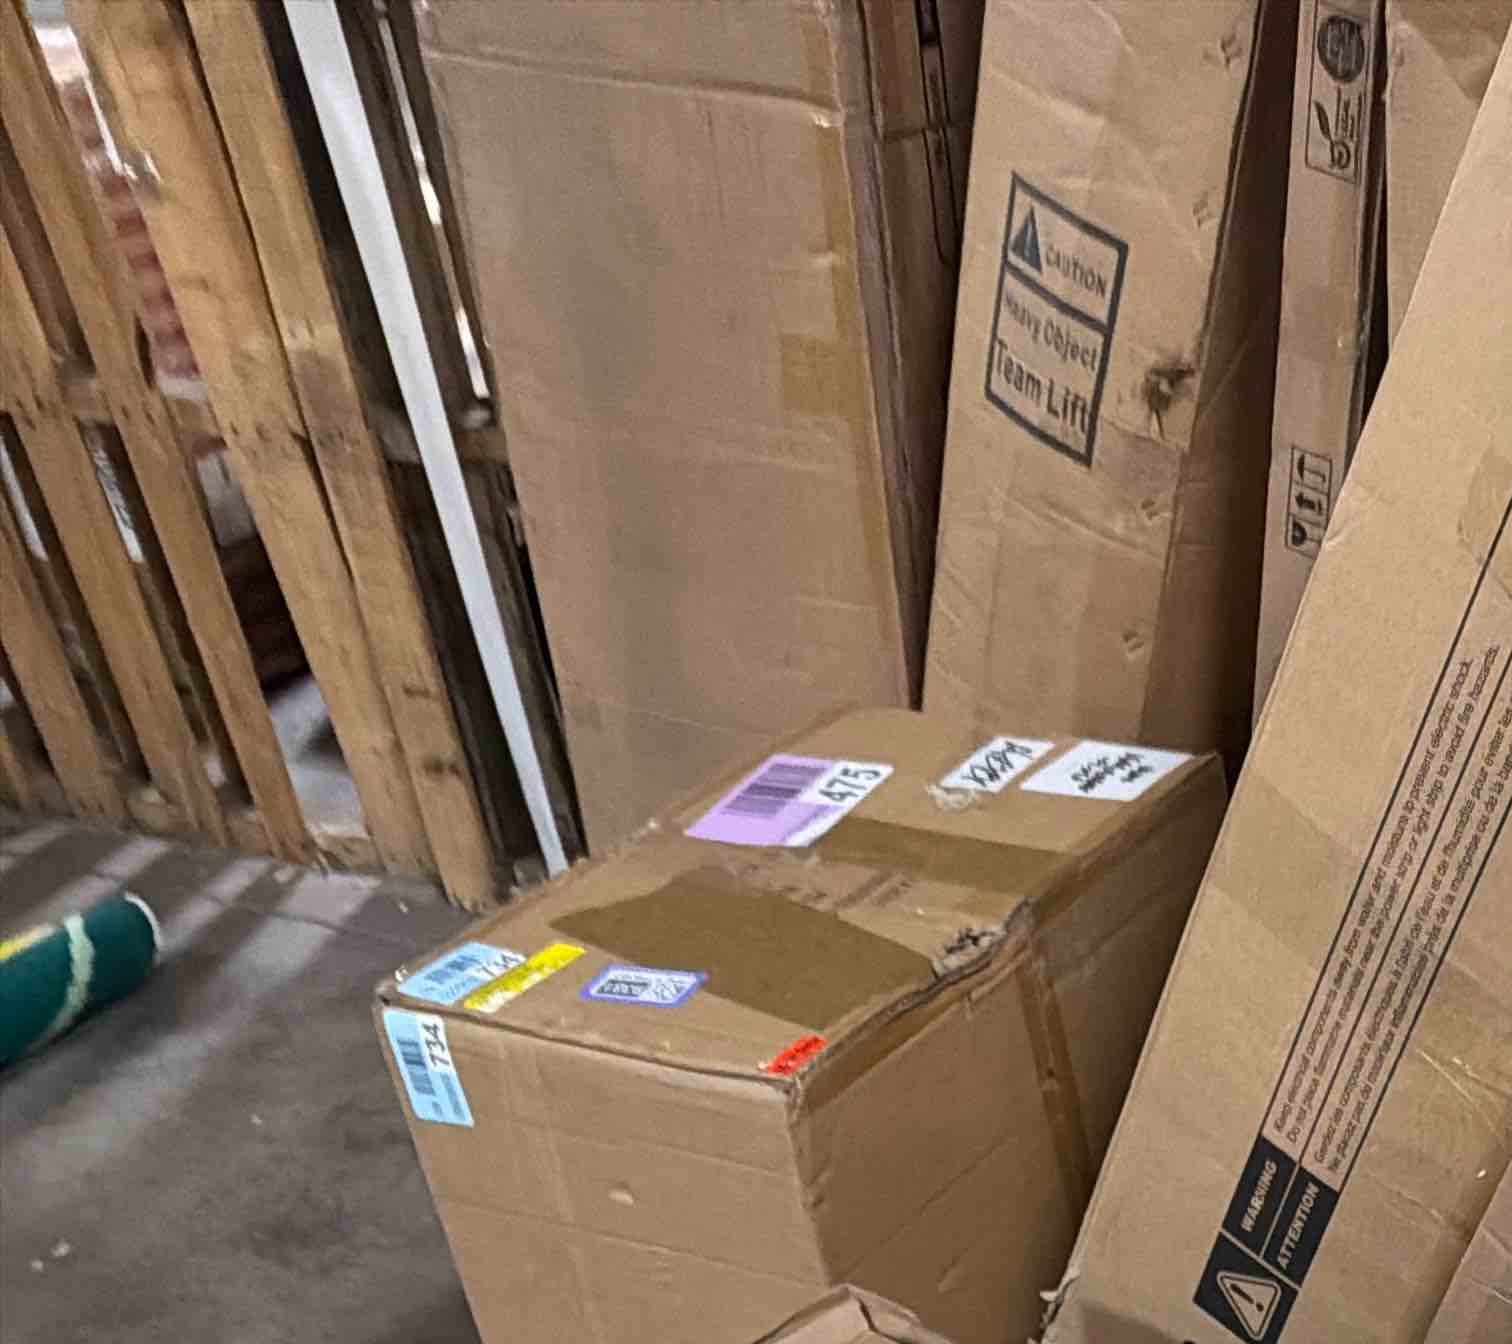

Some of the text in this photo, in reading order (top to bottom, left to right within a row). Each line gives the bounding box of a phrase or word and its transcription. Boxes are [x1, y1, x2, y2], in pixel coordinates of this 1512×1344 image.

[1045, 246, 1106, 298] CAUTION
[1044, 320, 1098, 372] Object
[995, 339, 1088, 434] Team Lift
[819, 767, 881, 802] 475
